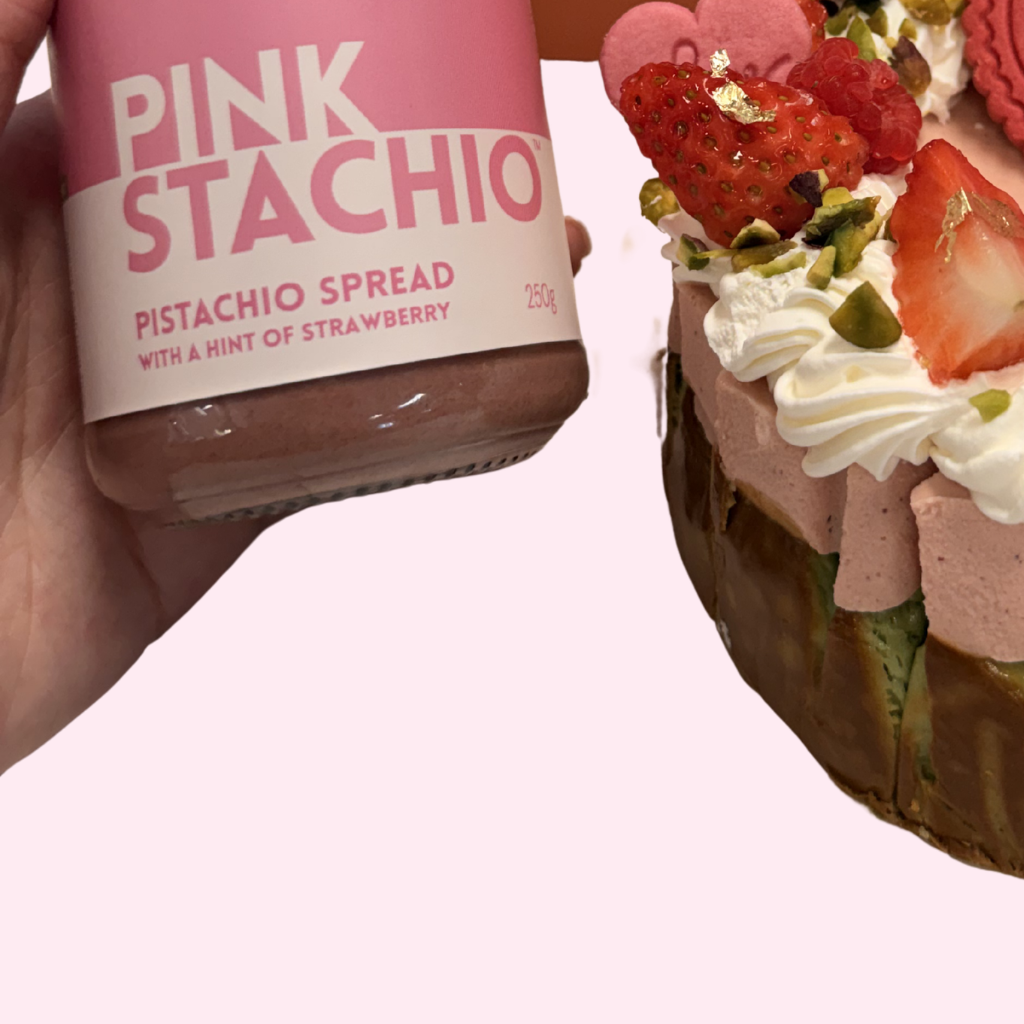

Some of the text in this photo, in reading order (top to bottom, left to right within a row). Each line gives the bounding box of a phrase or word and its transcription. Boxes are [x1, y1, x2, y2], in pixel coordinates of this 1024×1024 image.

[110, 41, 379, 176] PINK
[135, 261, 455, 340] PISTACHIO SPREAD
[525, 283, 557, 315] 250g
[138, 302, 451, 371] WITH A HINT OF STRAWBERRY
